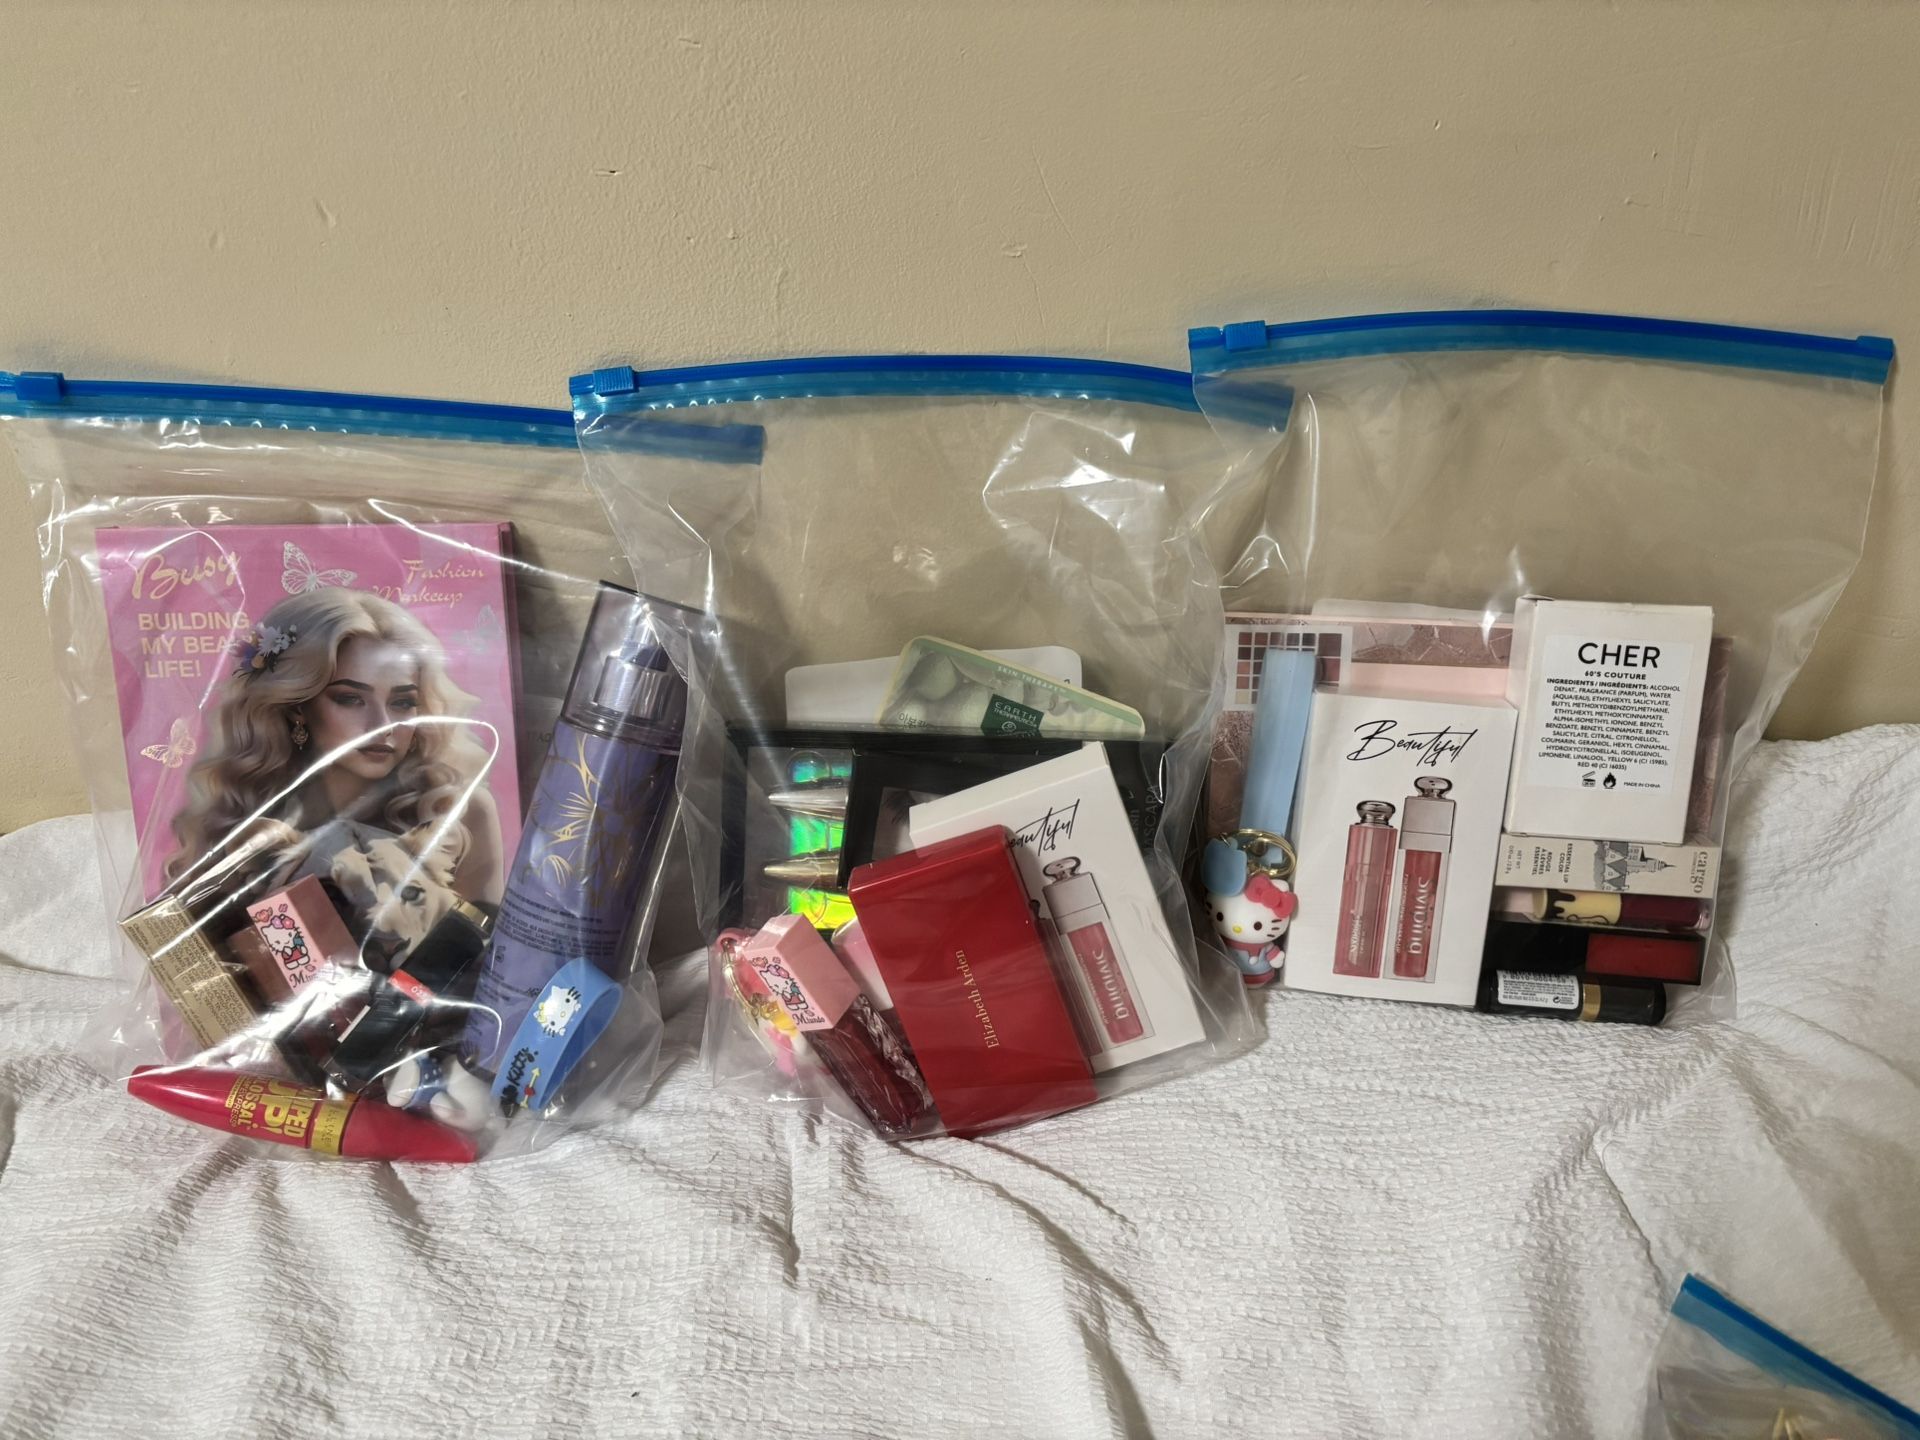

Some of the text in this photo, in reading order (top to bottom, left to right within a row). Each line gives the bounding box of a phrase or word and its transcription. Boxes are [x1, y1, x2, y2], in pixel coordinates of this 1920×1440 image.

[132, 551, 241, 600] Busy
[403, 559, 485, 583] Fashion
[373, 585, 464, 608] Makeup
[138, 612, 250, 631] BUILDING
[141, 636, 176, 655] MY
[1578, 642, 1660, 668] CHER
[144, 660, 202, 678] LIFE!
[997, 665, 1017, 676] SKIN
[1604, 671, 1646, 680] COUTURE
[1546, 677, 1594, 686] INGREDIENTS
[1649, 684, 1680, 692] ALCOHOL
[1578, 687, 1616, 695] FRAGRANCE
[1592, 695, 1631, 703] ETHYLHEXYL
[994, 700, 1036, 721] EARTH
[1554, 708, 1593, 716] ETHYLHEXYL
[1347, 720, 1478, 767] Beautiful
[1009, 798, 1080, 856] eautiful
[1531, 846, 1540, 875] ESSENTIEL
[1557, 852, 1565, 872] COLOR
[1563, 842, 1572, 873] ESSENTIAL
[1689, 850, 1708, 894] cargo
[954, 949, 999, 1048] Elizabeth Arden
